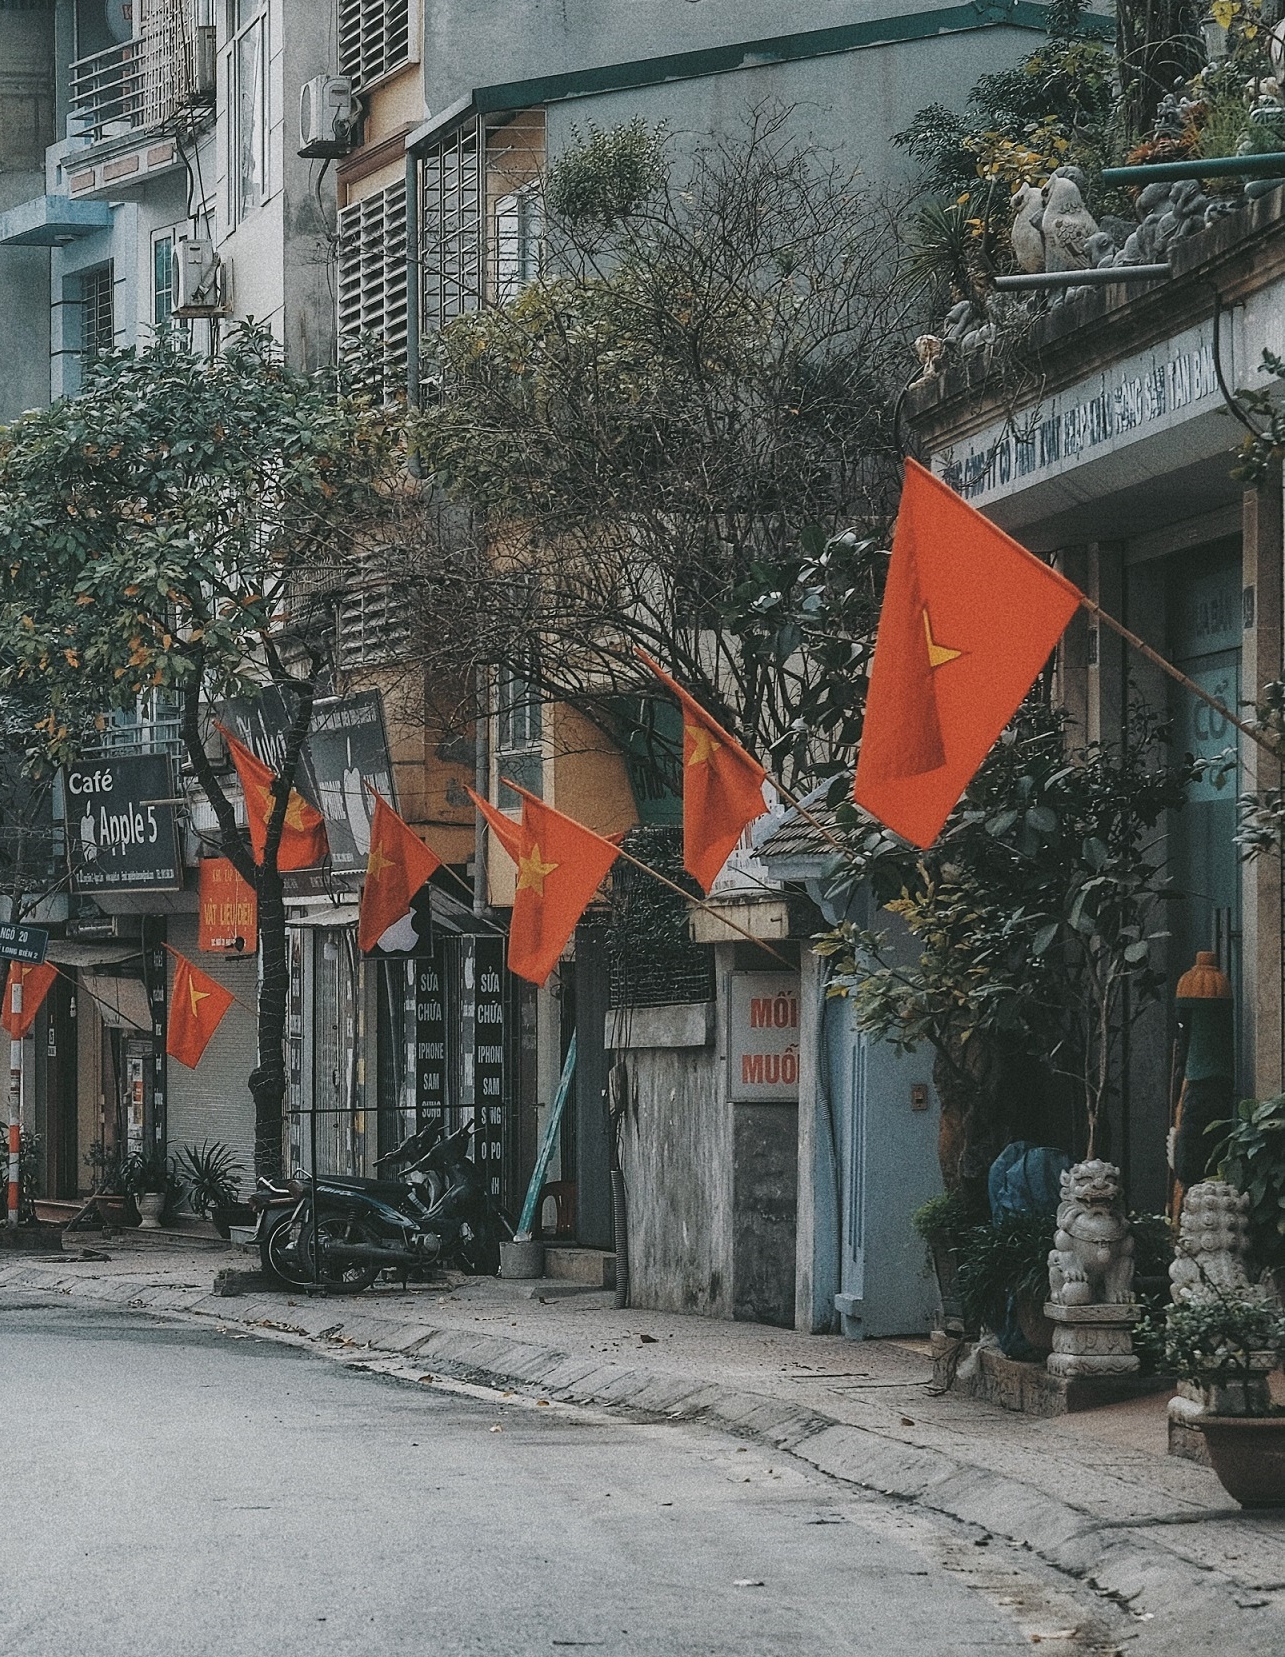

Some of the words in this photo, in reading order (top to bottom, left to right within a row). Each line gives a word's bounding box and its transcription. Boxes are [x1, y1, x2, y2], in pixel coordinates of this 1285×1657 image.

[69, 769, 113, 795] Café
[100, 802, 145, 856] Apple
[147, 806, 158, 843] 5
[18, 930, 29, 943] 20
[1, 946, 18, 955] LONG
[18, 949, 33, 959] BIÊN
[420, 966, 439, 992] SỬA
[480, 966, 500, 993] SỬA
[418, 998, 442, 1022] CHỮA
[477, 1000, 503, 1024] CHỮA
[751, 990, 797, 1029] MỐI
[418, 1042, 444, 1060] IPHONE
[423, 1073, 440, 1090] SAM
[483, 1077, 500, 1096] SAM
[481, 1106, 501, 1125] SNG
[481, 1141, 501, 1160] OPO
